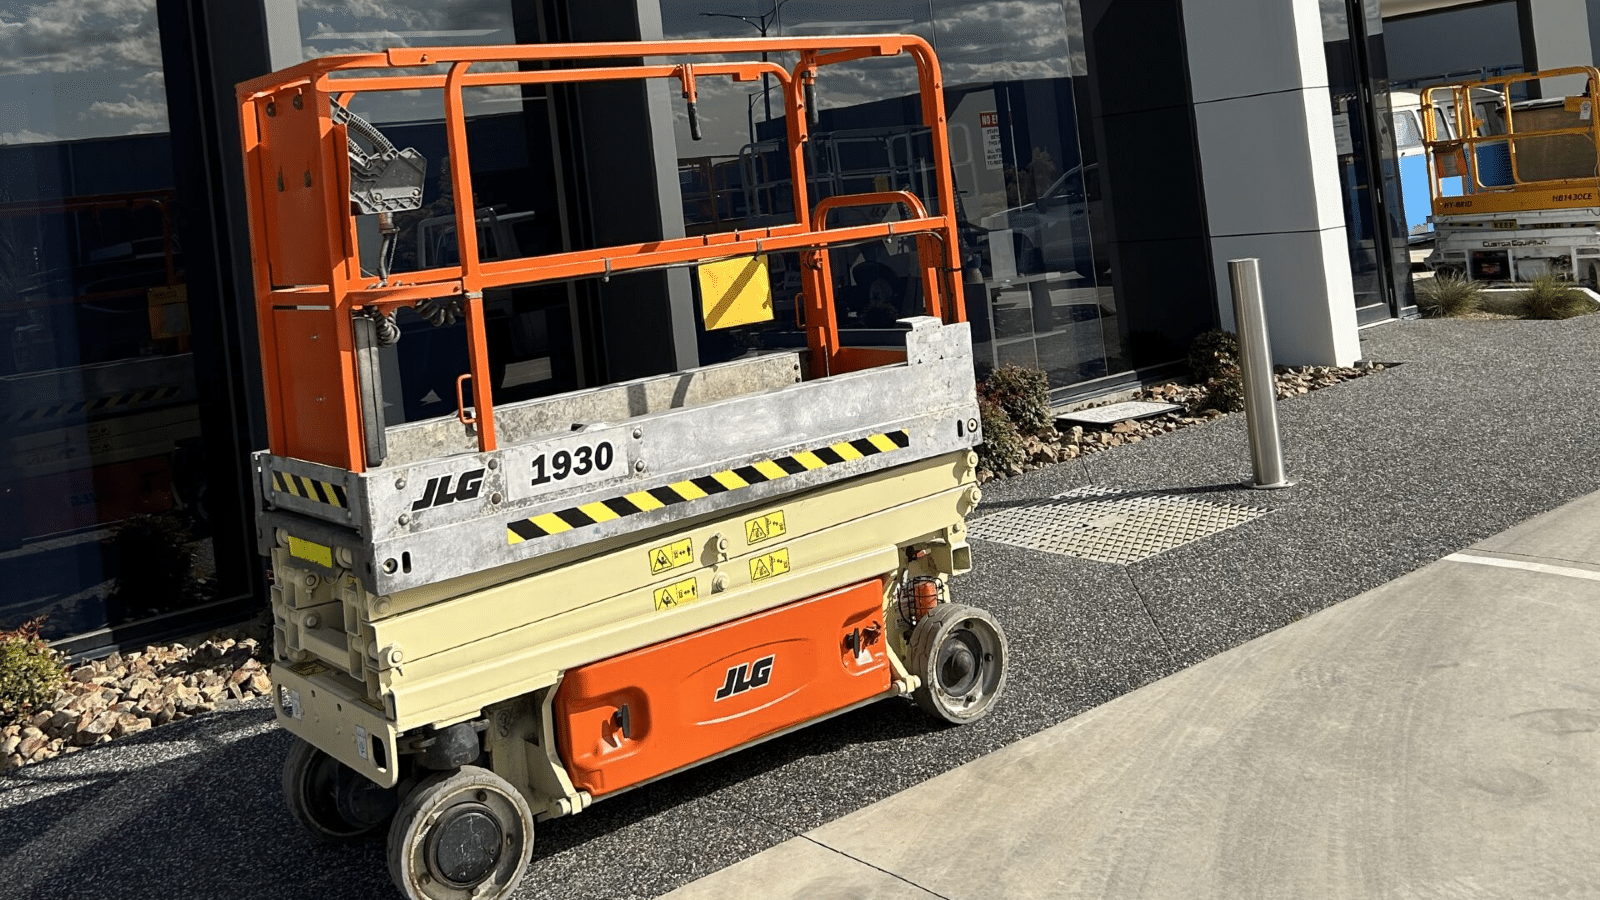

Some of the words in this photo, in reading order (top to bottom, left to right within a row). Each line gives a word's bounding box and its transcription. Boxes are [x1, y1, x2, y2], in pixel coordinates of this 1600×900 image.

[982, 115, 991, 125] NO
[1552, 192, 1593, 202] HB1430CE
[1495, 221, 1515, 229] KEEP
[531, 442, 614, 486] 1930
[411, 468, 487, 512] JLG
[714, 654, 776, 702] JLG
